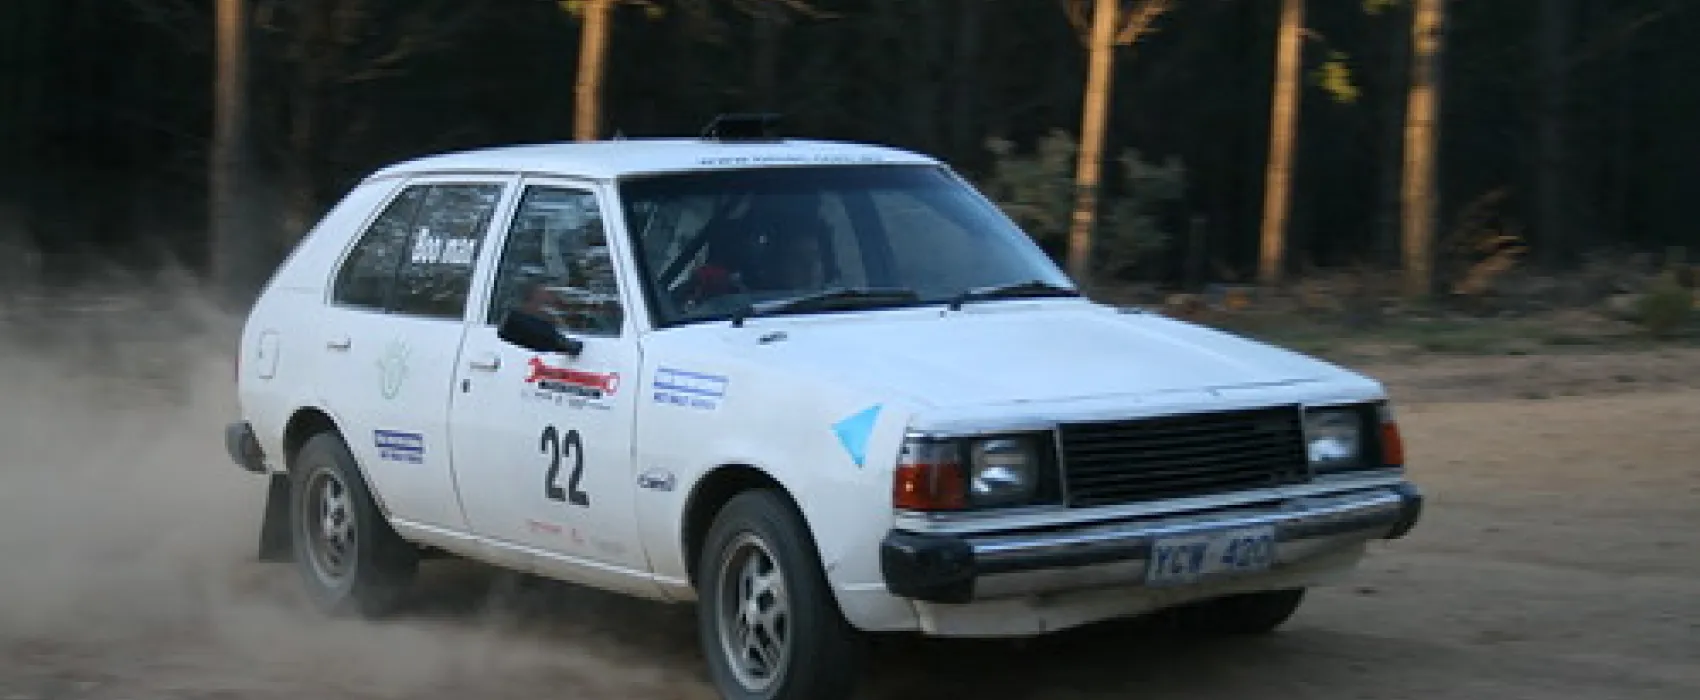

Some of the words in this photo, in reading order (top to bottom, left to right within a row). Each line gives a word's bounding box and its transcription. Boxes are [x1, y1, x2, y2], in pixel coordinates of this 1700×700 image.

[539, 423, 589, 507] 22
[1156, 542, 1207, 576] YCW
[1221, 535, 1272, 568] 420
